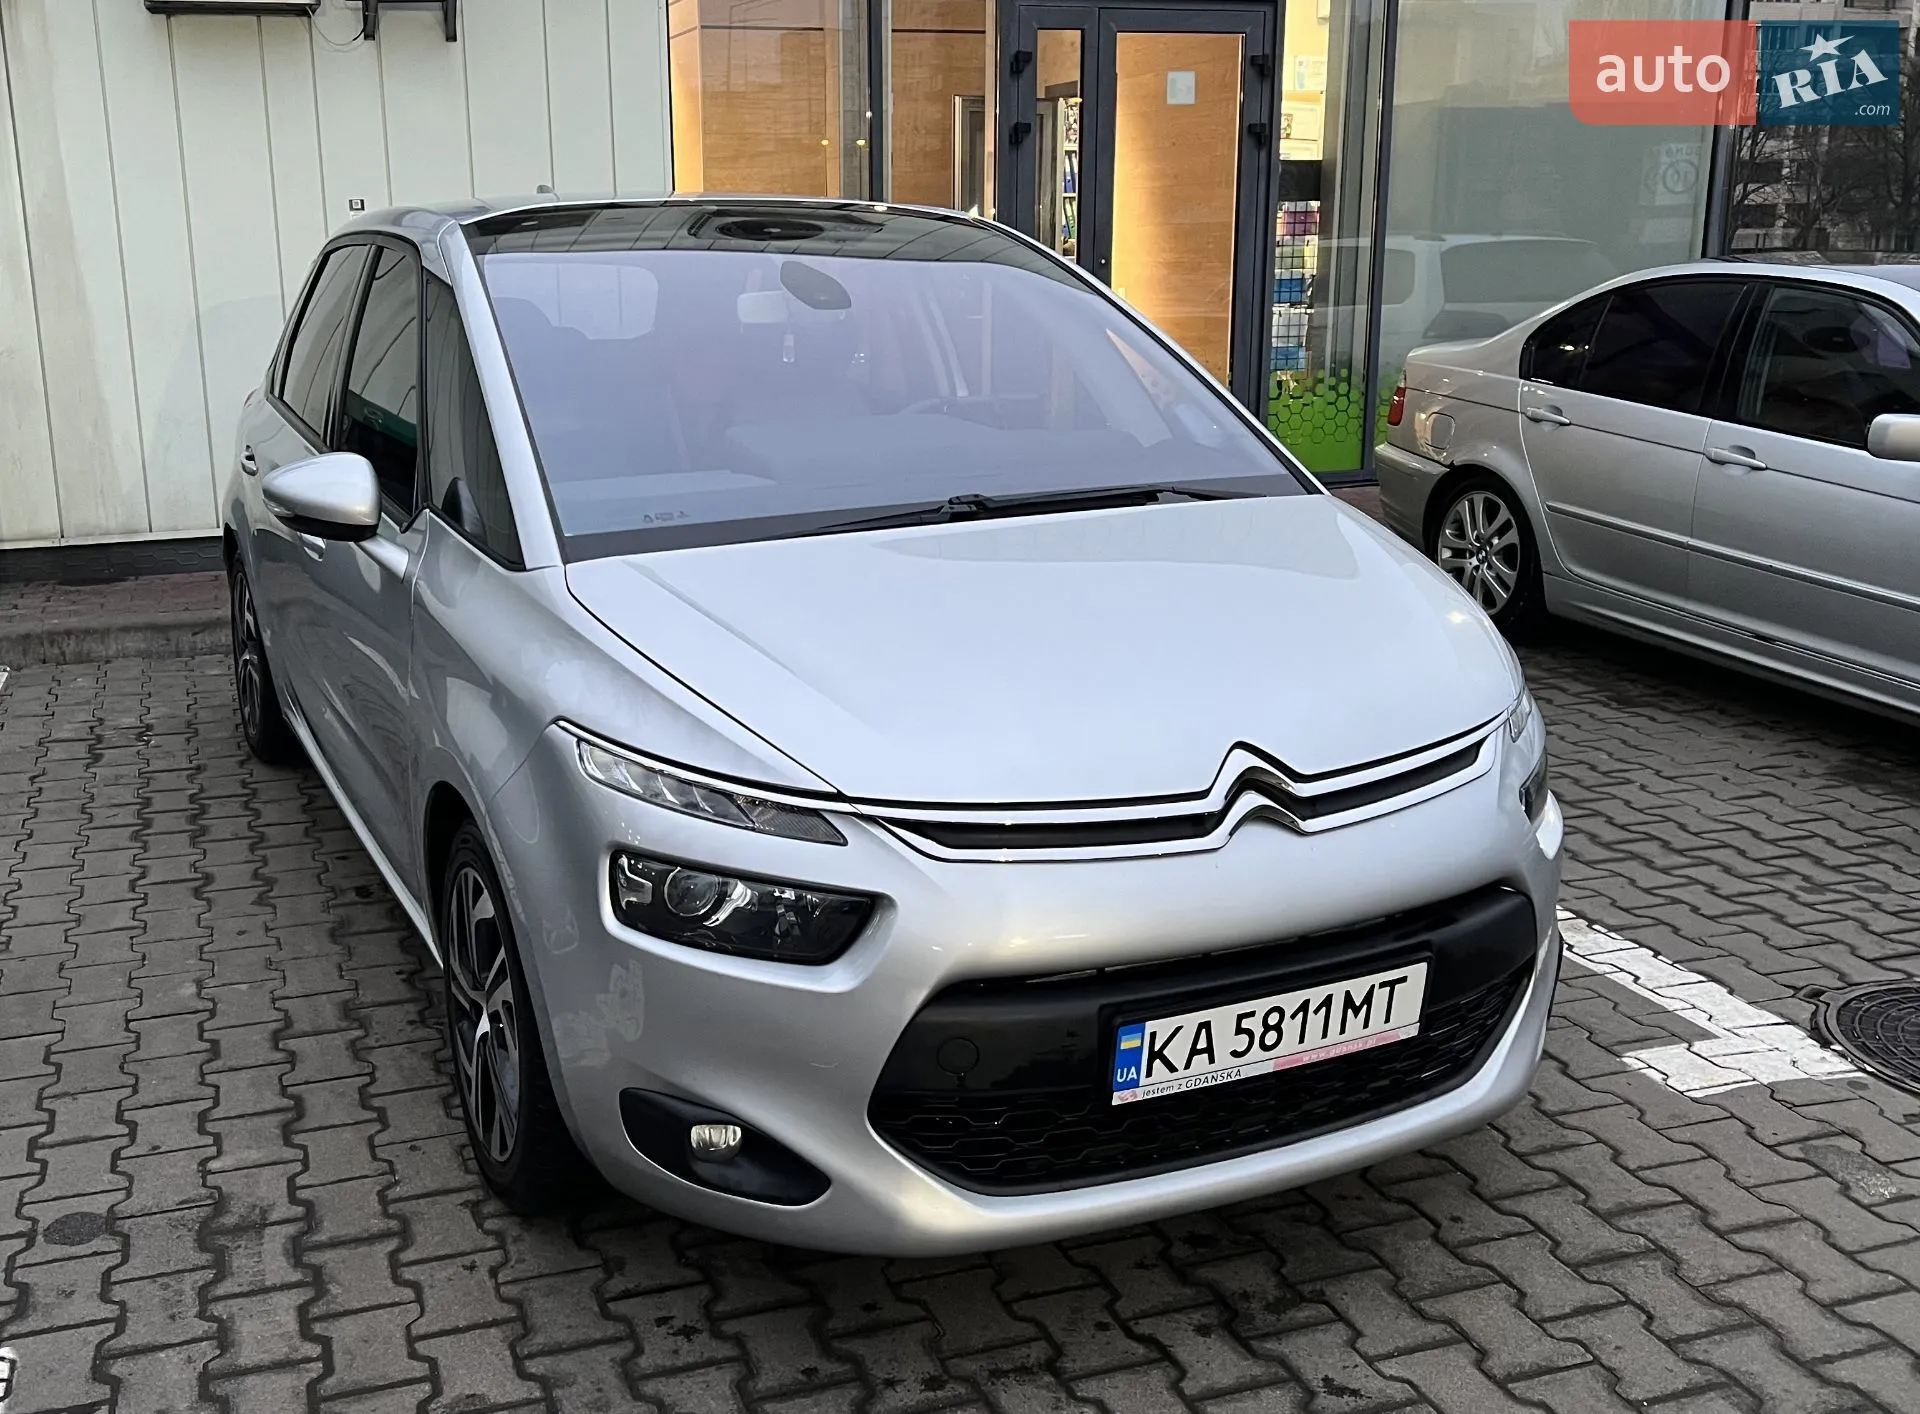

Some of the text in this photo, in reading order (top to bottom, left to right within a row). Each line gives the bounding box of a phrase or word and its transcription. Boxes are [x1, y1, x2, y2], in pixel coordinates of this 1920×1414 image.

[1145, 1020, 1216, 1079] KA
[1116, 1066, 1138, 1083] UA
[1142, 1085, 1174, 1099] jestem
